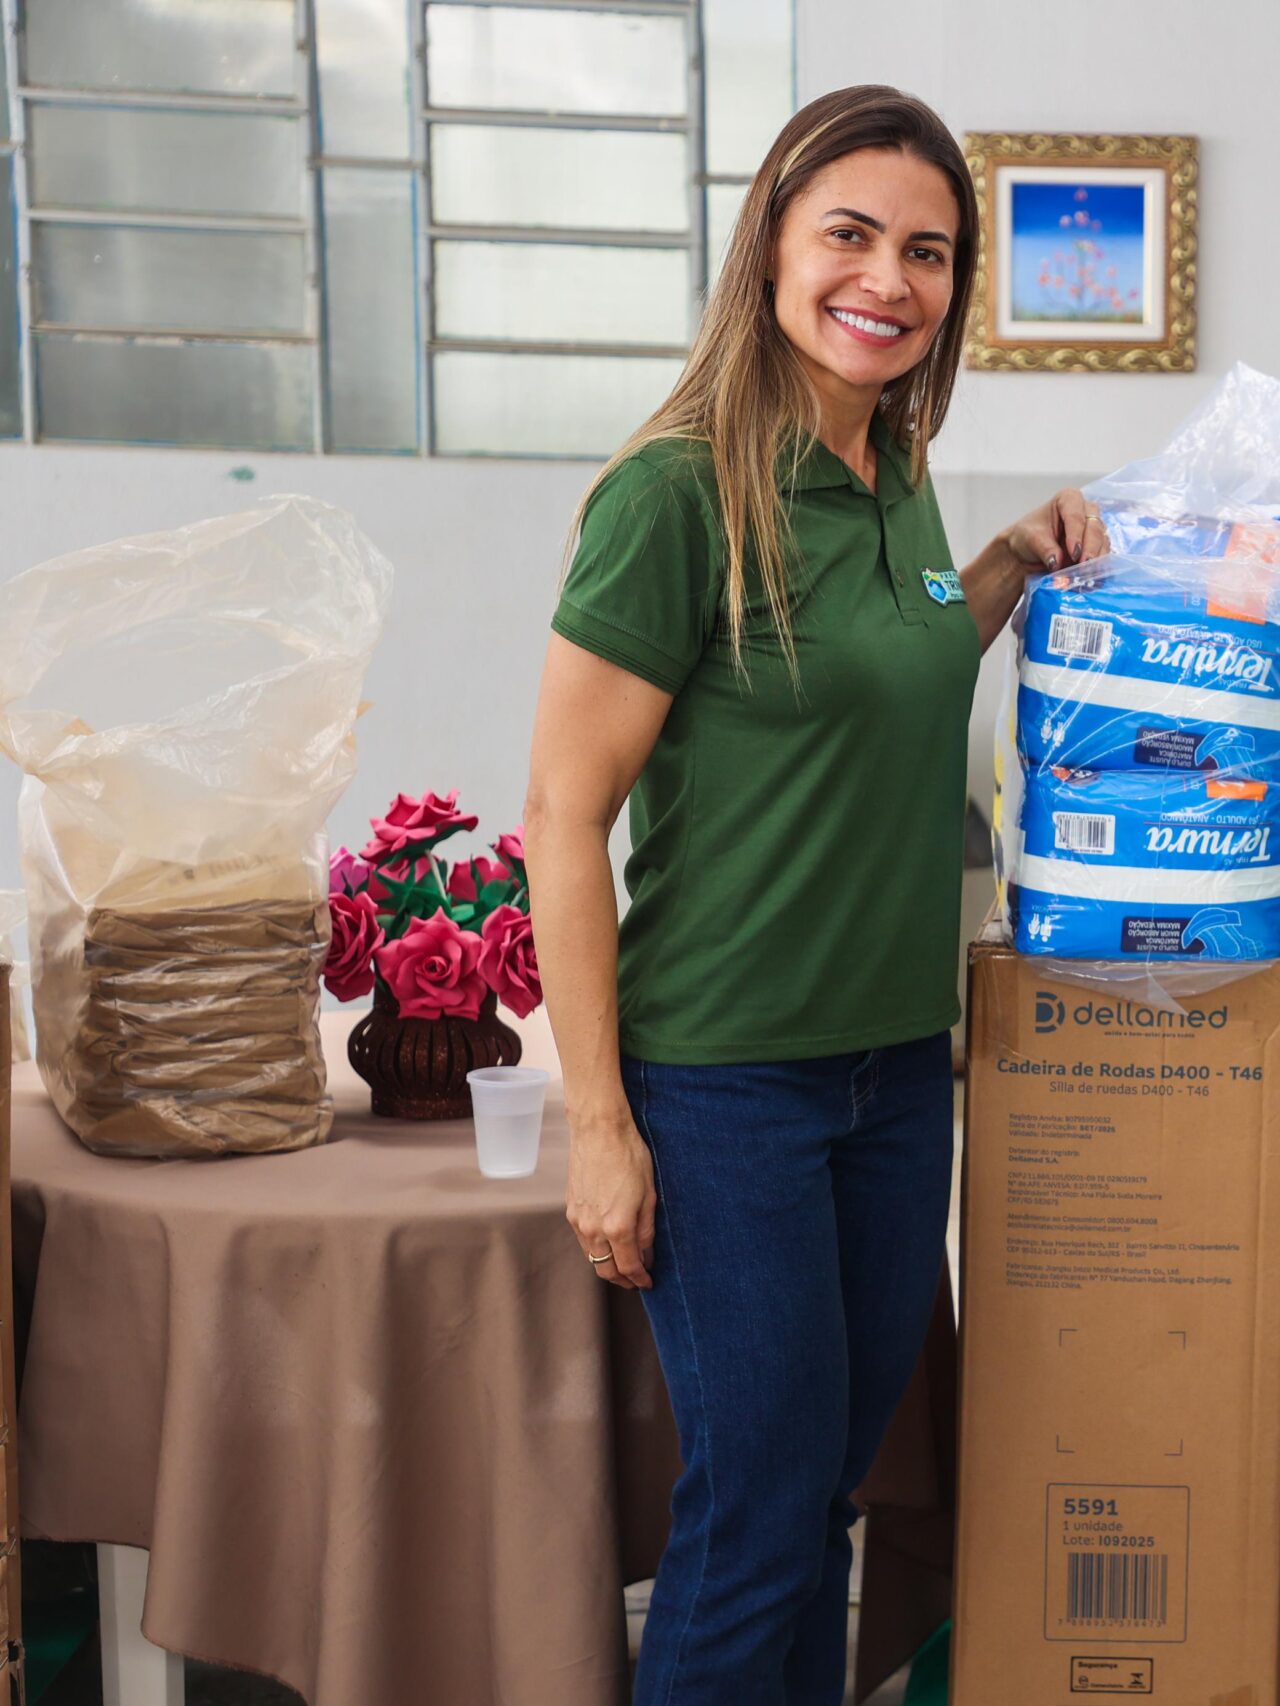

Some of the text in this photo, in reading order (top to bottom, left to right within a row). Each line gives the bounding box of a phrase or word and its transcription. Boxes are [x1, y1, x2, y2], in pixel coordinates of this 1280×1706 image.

[1142, 638, 1272, 693] Ternura
[1217, 814, 1247, 825] ADULTO
[1145, 826, 1271, 863] Ternura
[1128, 919, 1181, 931] MÁXIMA VEDAÇÃO
[1159, 929, 1180, 938] MAIOR
[1158, 944, 1179, 952] DUPLO
[1073, 1000, 1228, 1030] dellamed
[997, 1058, 1066, 1077] Cadeira
[1072, 1062, 1094, 1077] de
[1100, 1063, 1156, 1079] Rodas
[1161, 1065, 1210, 1081] D400
[1229, 1066, 1263, 1081] T46
[1050, 1081, 1074, 1094] Silla
[1078, 1082, 1093, 1095] de
[1097, 1083, 1138, 1096] ruedas
[1142, 1085, 1174, 1096] D400
[1186, 1086, 1209, 1097] T46
[1063, 1498, 1118, 1516] 5591
[1063, 1520, 1123, 1532] 1 unidade
[1063, 1535, 1095, 1546] Lote:
